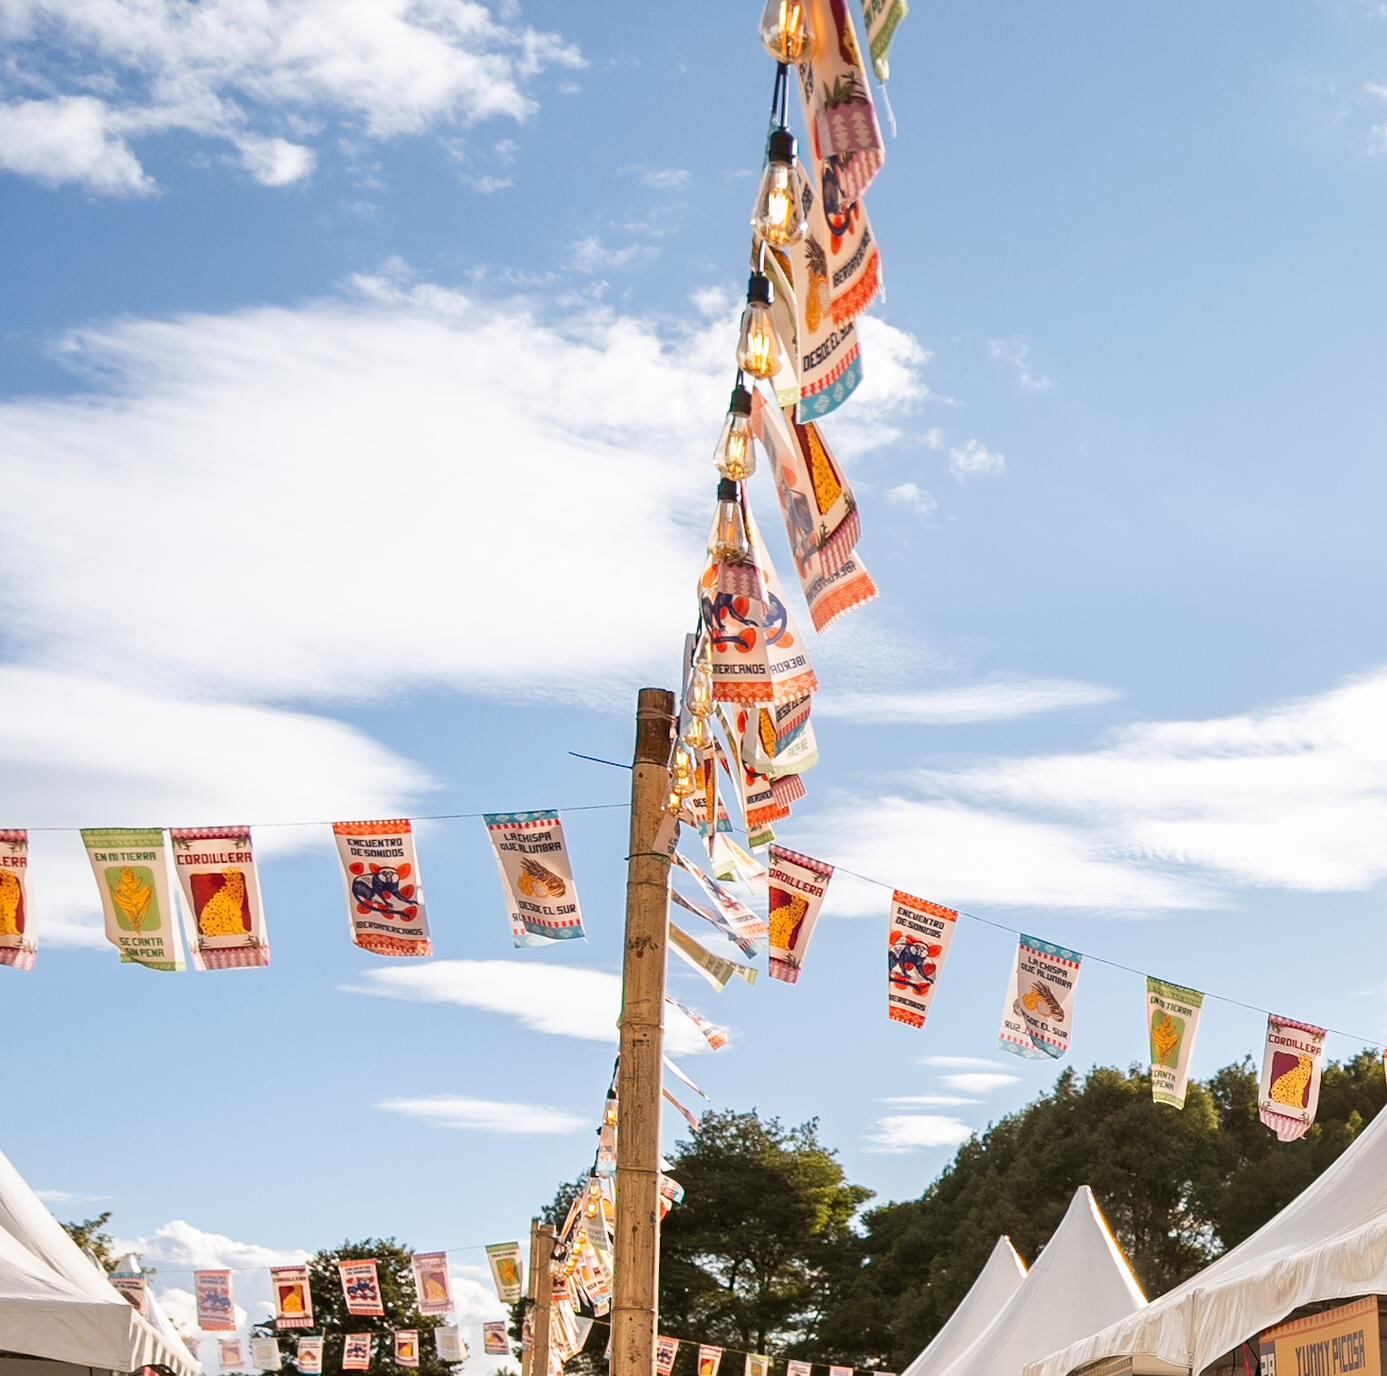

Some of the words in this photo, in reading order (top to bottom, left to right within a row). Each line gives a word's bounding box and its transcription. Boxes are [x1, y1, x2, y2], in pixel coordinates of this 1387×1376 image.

[803, 338, 831, 373] DESDE
[347, 837, 403, 847] ENCUENTRO
[504, 832, 517, 842] LA
[517, 831, 552, 843] CHISPA
[350, 847, 363, 857] DE
[365, 847, 404, 858] SONIDOS
[500, 842, 517, 852] QUE
[95, 851, 107, 862] EN
[120, 851, 156, 861] TIERRA
[177, 852, 252, 866] CORDILLERA
[769, 867, 824, 898] ORDILLERA
[518, 901, 542, 915] DESDE
[543, 906, 556, 916] EL
[557, 903, 576, 915] SUR
[895, 916, 907, 927] DE
[896, 907, 945, 930] ENCUENTRO
[120, 937, 130, 946] SE
[131, 937, 163, 947] CANTA
[140, 947, 164, 958] PENA
[1020, 962, 1036, 975] QUE
[1028, 956, 1038, 966] LA
[1038, 960, 1068, 978] CHISPA
[1165, 1002, 1193, 1018] TIERRA
[1041, 1021, 1052, 1033] EL
[1052, 1025, 1068, 1040] SUR
[1268, 1033, 1322, 1057] CORDILLERA
[1332, 1329, 1366, 1376] PICOSA
